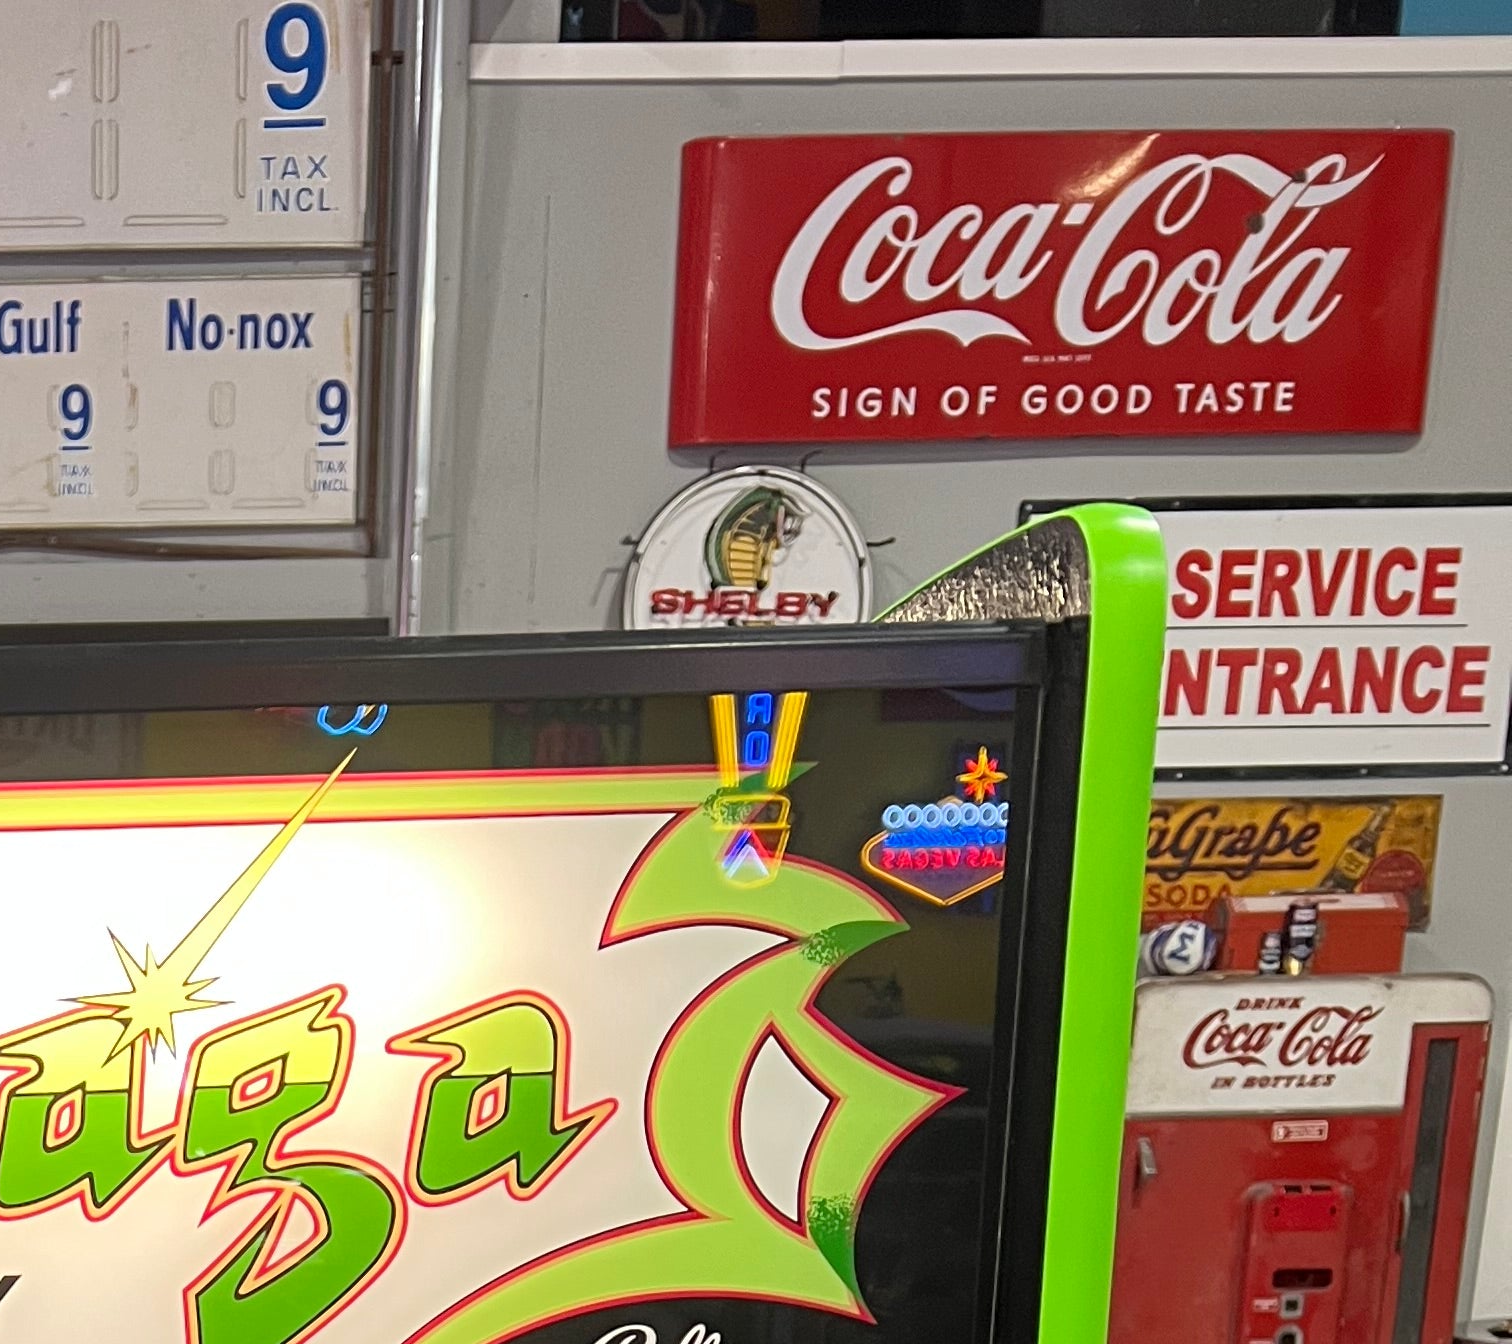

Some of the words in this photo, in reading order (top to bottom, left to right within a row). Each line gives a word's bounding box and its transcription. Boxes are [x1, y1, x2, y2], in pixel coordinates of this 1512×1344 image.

[264, 2, 329, 112] 9
[260, 155, 327, 180] TAX
[771, 153, 1385, 349] Coca-Cola
[61, 384, 91, 440] 9
[319, 380, 348, 436] 9
[812, 386, 917, 418] SIGN
[940, 385, 997, 415] OF
[1021, 384, 1152, 415] GOOD
[1175, 382, 1296, 412] TASTE
[651, 588, 839, 617] SHELBY
[1171, 547, 1462, 619] SERVICE
[1163, 645, 1491, 716] NTRANCE
[1147, 884, 1232, 907] SODA
[1235, 996, 1305, 1011] DRINK
[1183, 1005, 1385, 1069] Coca-Cola
[1211, 1076, 1236, 1089] IN
[1242, 1074, 1336, 1089] BOTTLES
